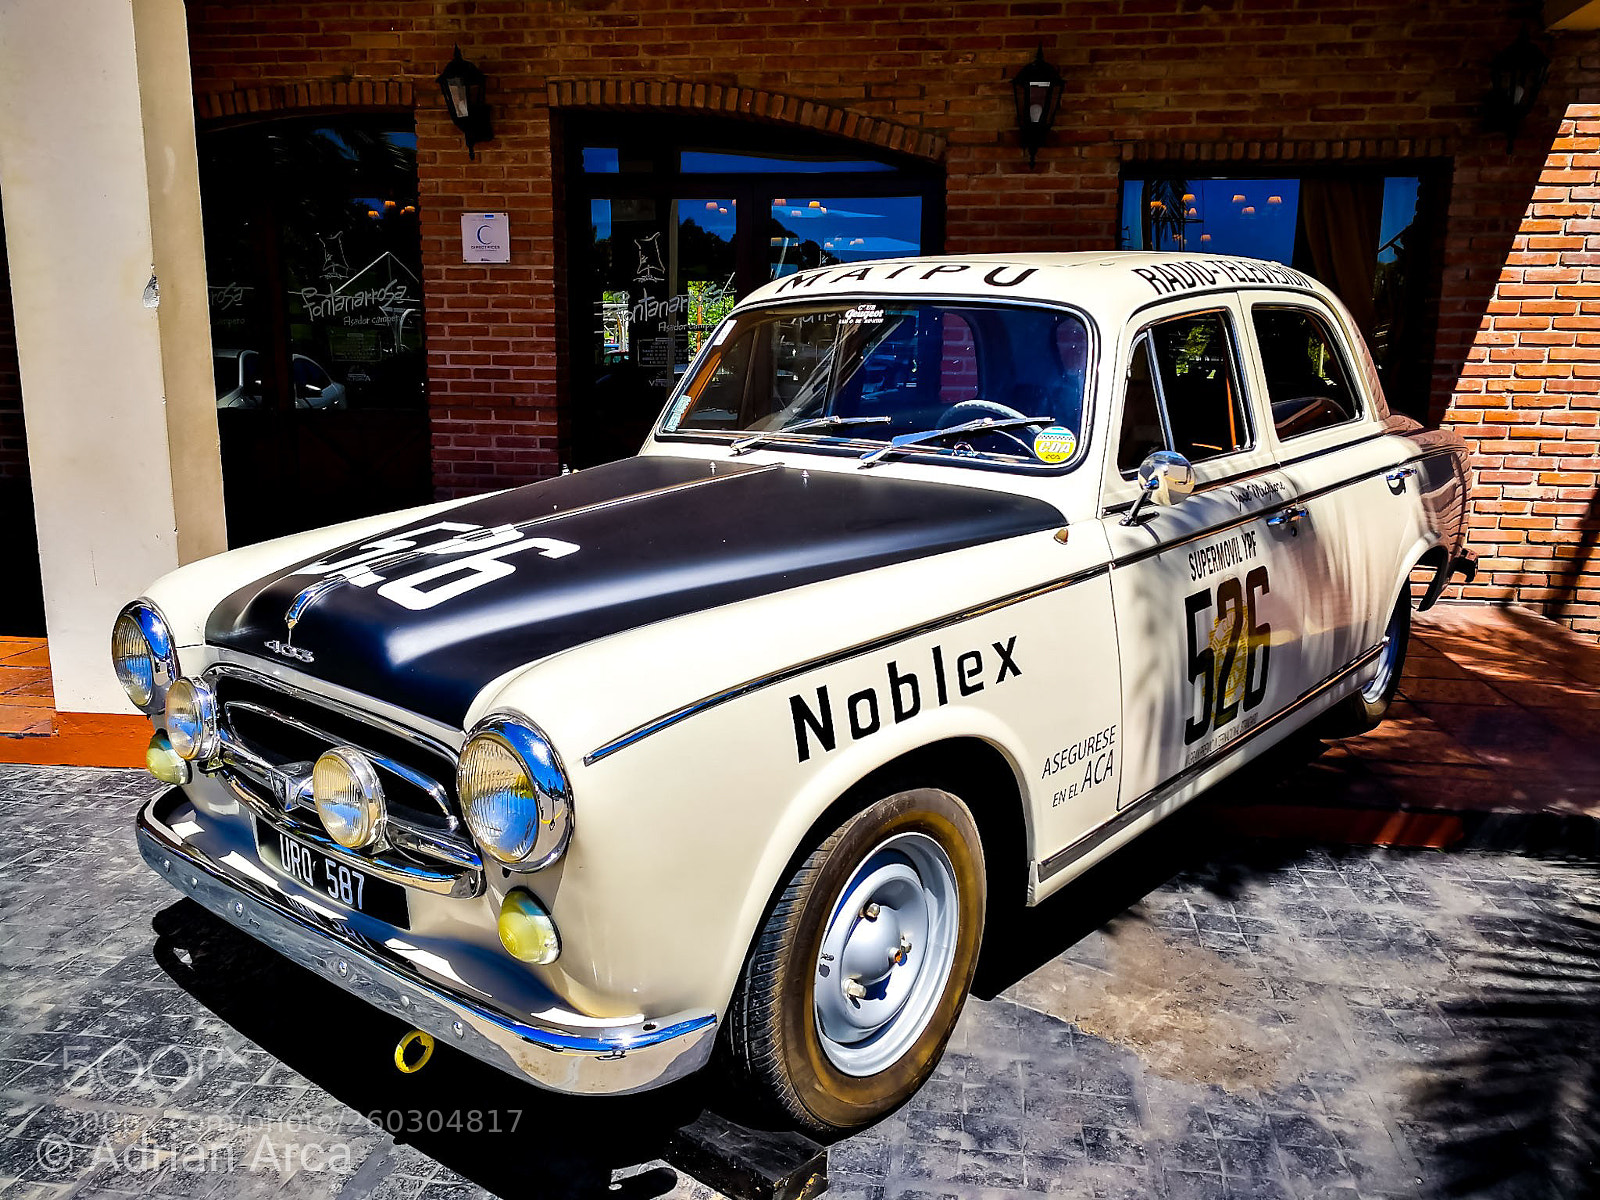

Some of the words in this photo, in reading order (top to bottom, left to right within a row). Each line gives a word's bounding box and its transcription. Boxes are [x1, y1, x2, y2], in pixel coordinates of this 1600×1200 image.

[301, 278, 408, 322] Fontanarrosa
[775, 264, 1039, 294] MAIPU
[1131, 259, 1313, 296] RADIO-TELEVISION
[291, 520, 581, 611] 526
[1188, 536, 1243, 582] SUPERMOVIL
[1241, 530, 1257, 560] YPF
[1184, 565, 1271, 746] 526
[788, 635, 1023, 764] Noblex
[1041, 724, 1117, 780] ASEGURESE
[1052, 788, 1067, 808] EN
[1068, 782, 1079, 800] EL
[1080, 748, 1114, 793] ACA
[324, 857, 365, 910] 587
